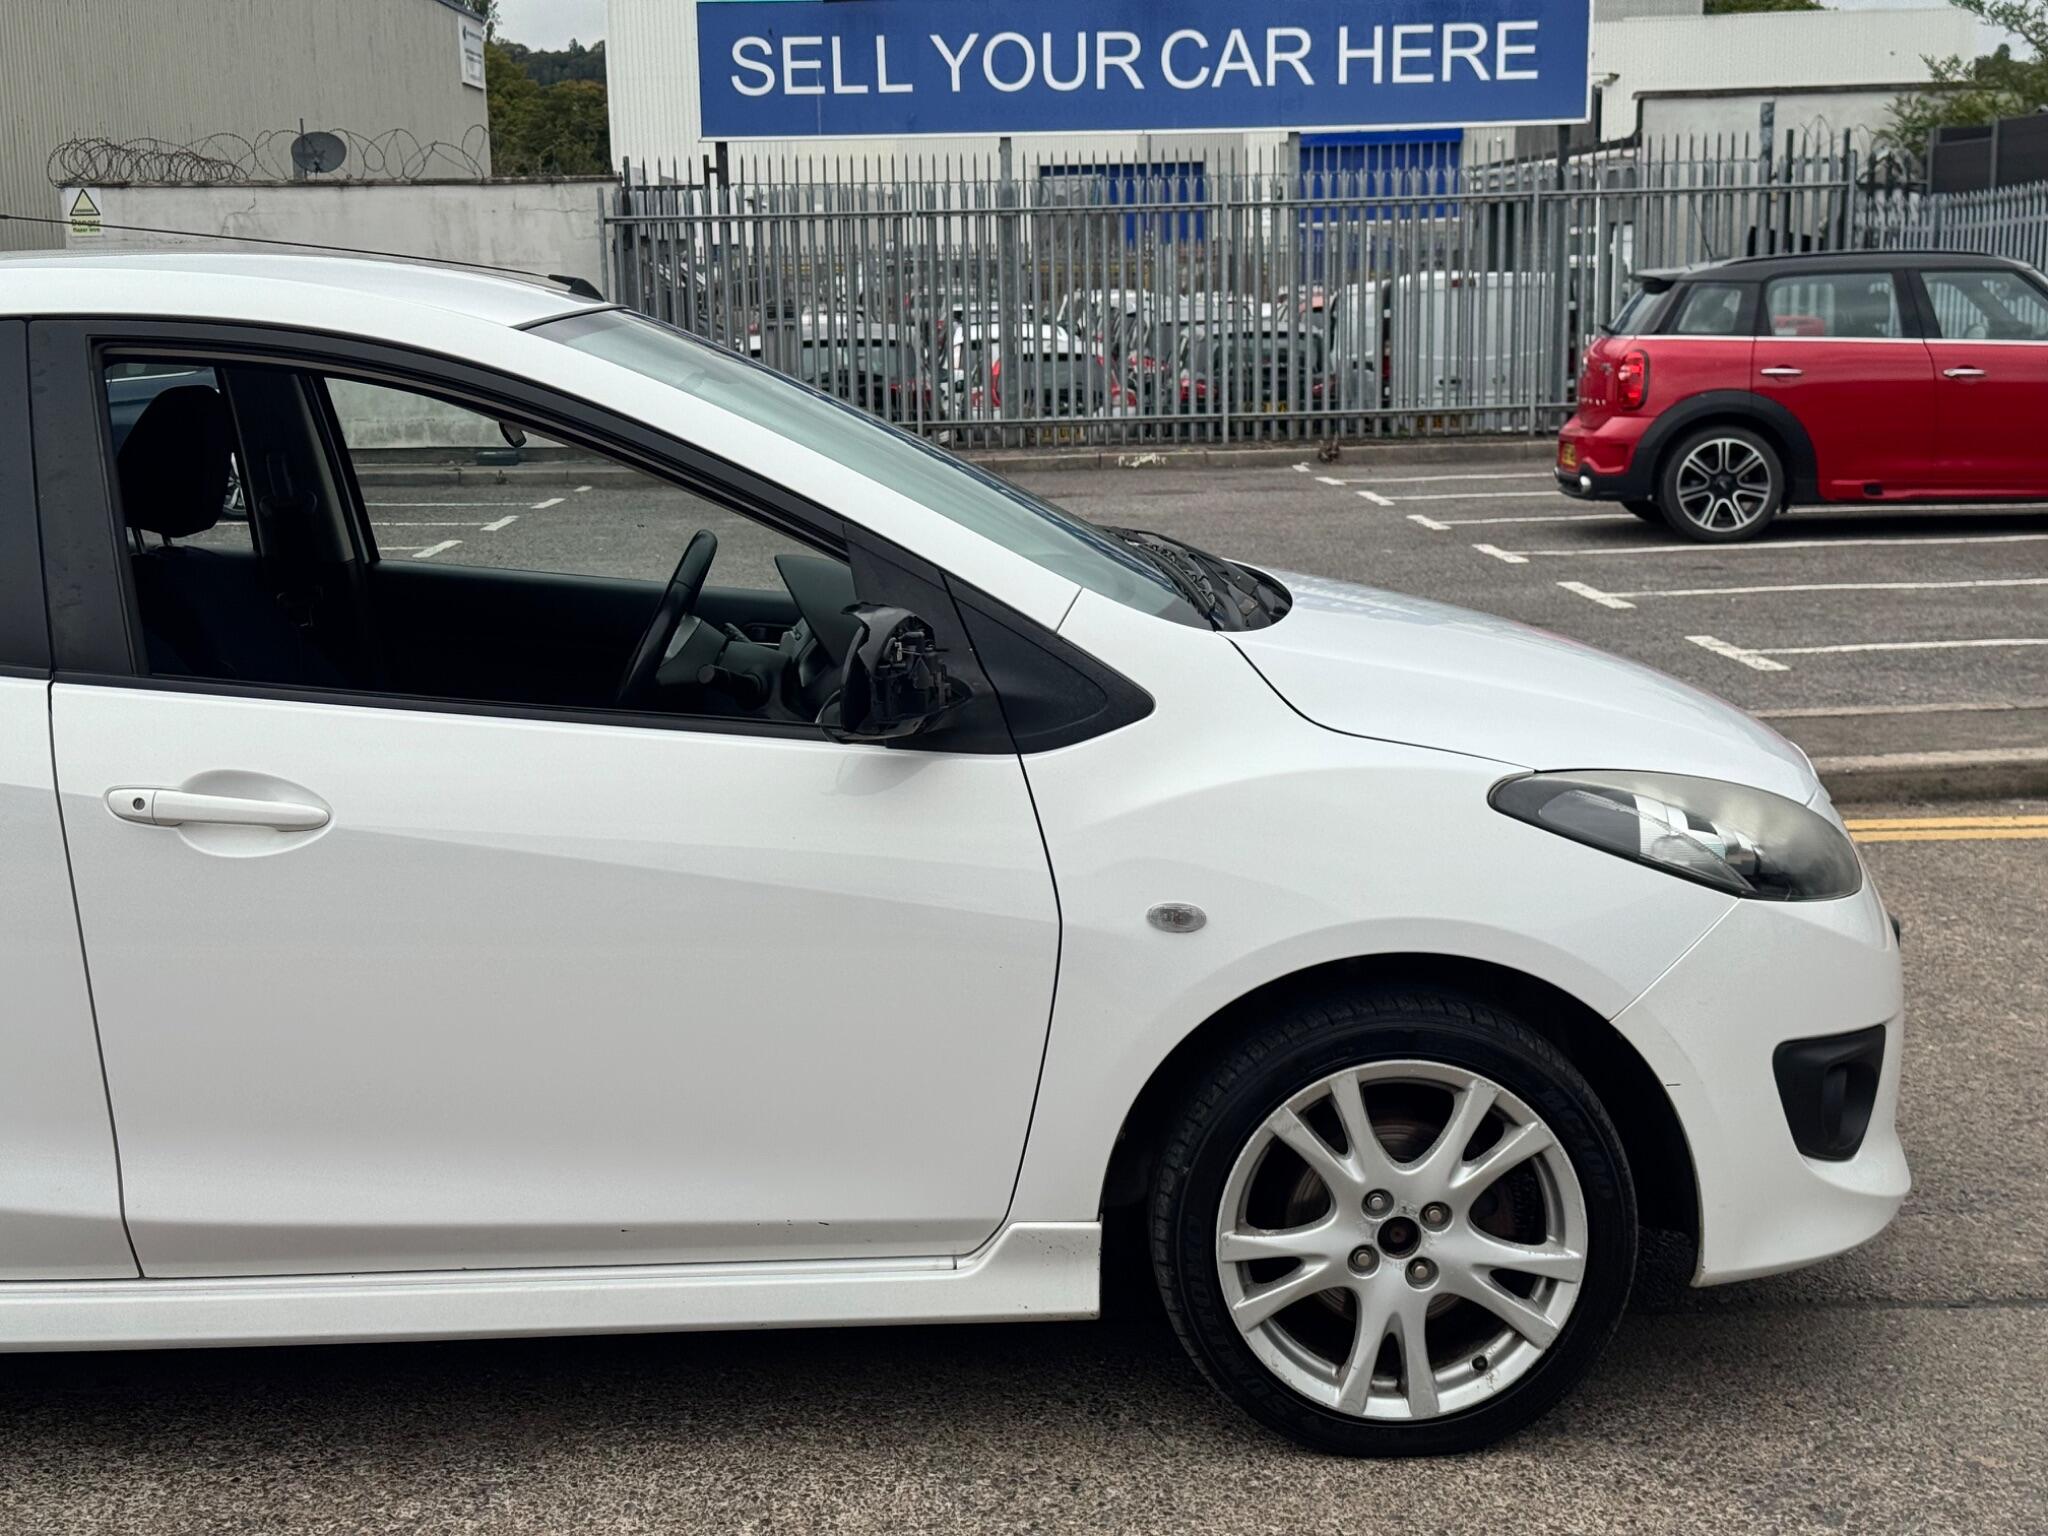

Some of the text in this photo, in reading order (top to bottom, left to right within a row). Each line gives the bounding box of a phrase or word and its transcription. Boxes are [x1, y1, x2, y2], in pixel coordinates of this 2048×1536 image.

[731, 21, 1539, 97] SELL YOUR CAR HERE
